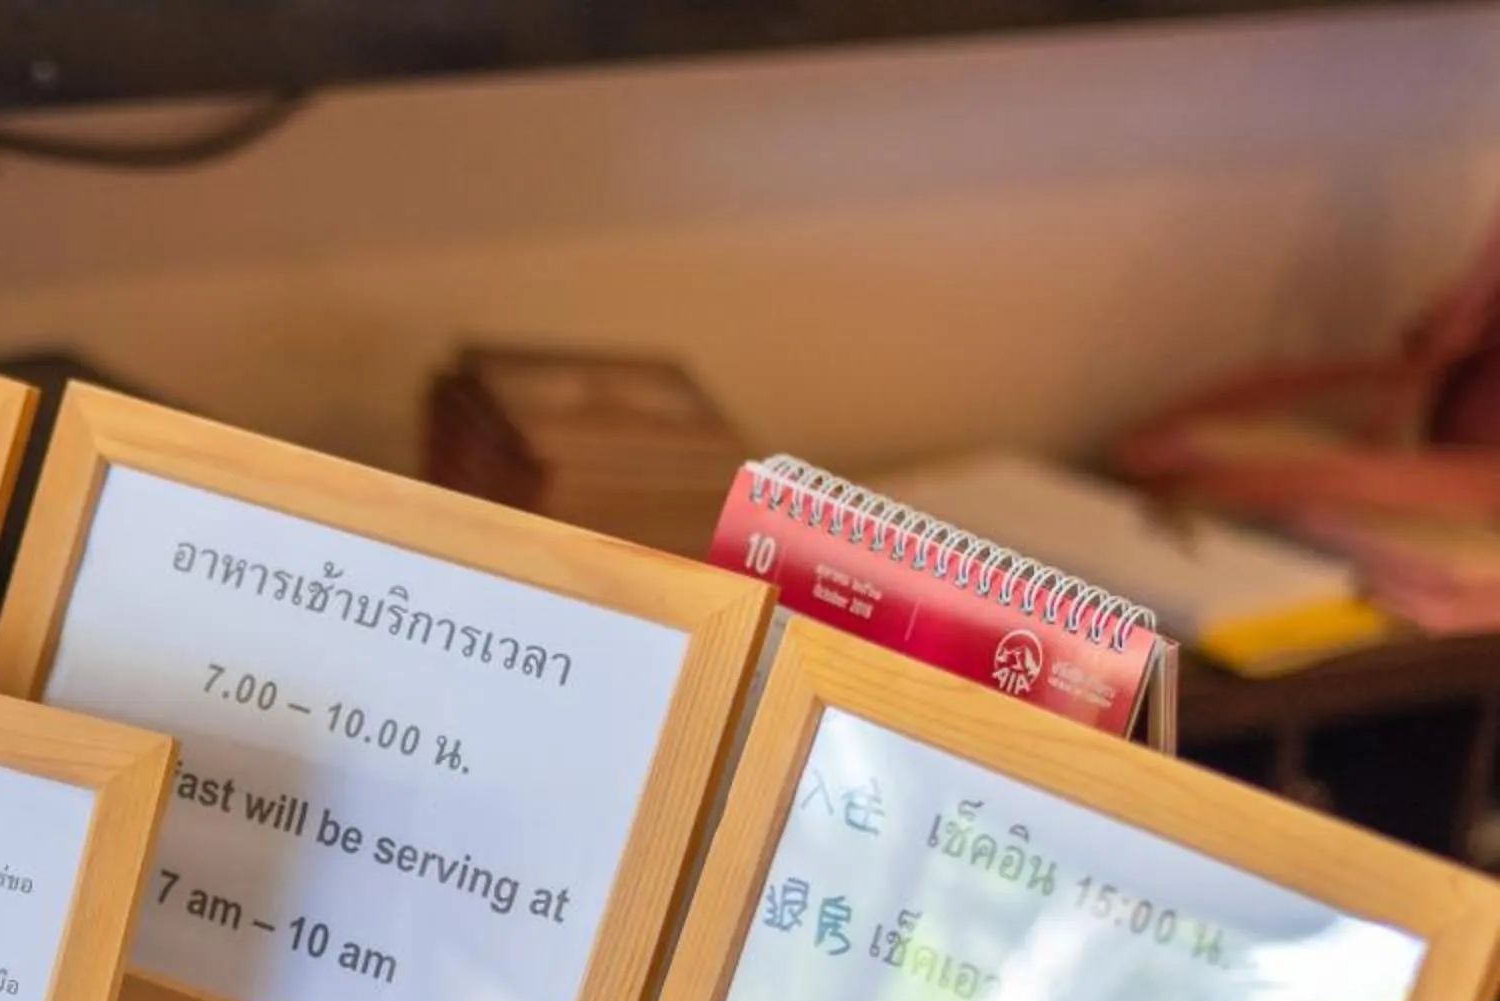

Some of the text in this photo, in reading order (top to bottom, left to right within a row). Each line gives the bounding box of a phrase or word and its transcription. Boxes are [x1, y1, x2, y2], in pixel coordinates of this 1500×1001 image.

[744, 532, 776, 575] 10
[172, 540, 573, 688] อาหารเช้าบริการเวลา
[201, 663, 279, 711] 7.00
[325, 702, 422, 757] 10.00
[434, 732, 471, 776] น.
[992, 666, 1031, 696] AIA
[174, 760, 572, 924] ast will be serving at
[926, 799, 1058, 897] เช็คอิน
[1074, 874, 1177, 945] 15:00
[156, 869, 181, 906] 7
[186, 887, 243, 932] am
[289, 916, 331, 960] 10
[337, 941, 398, 986] am
